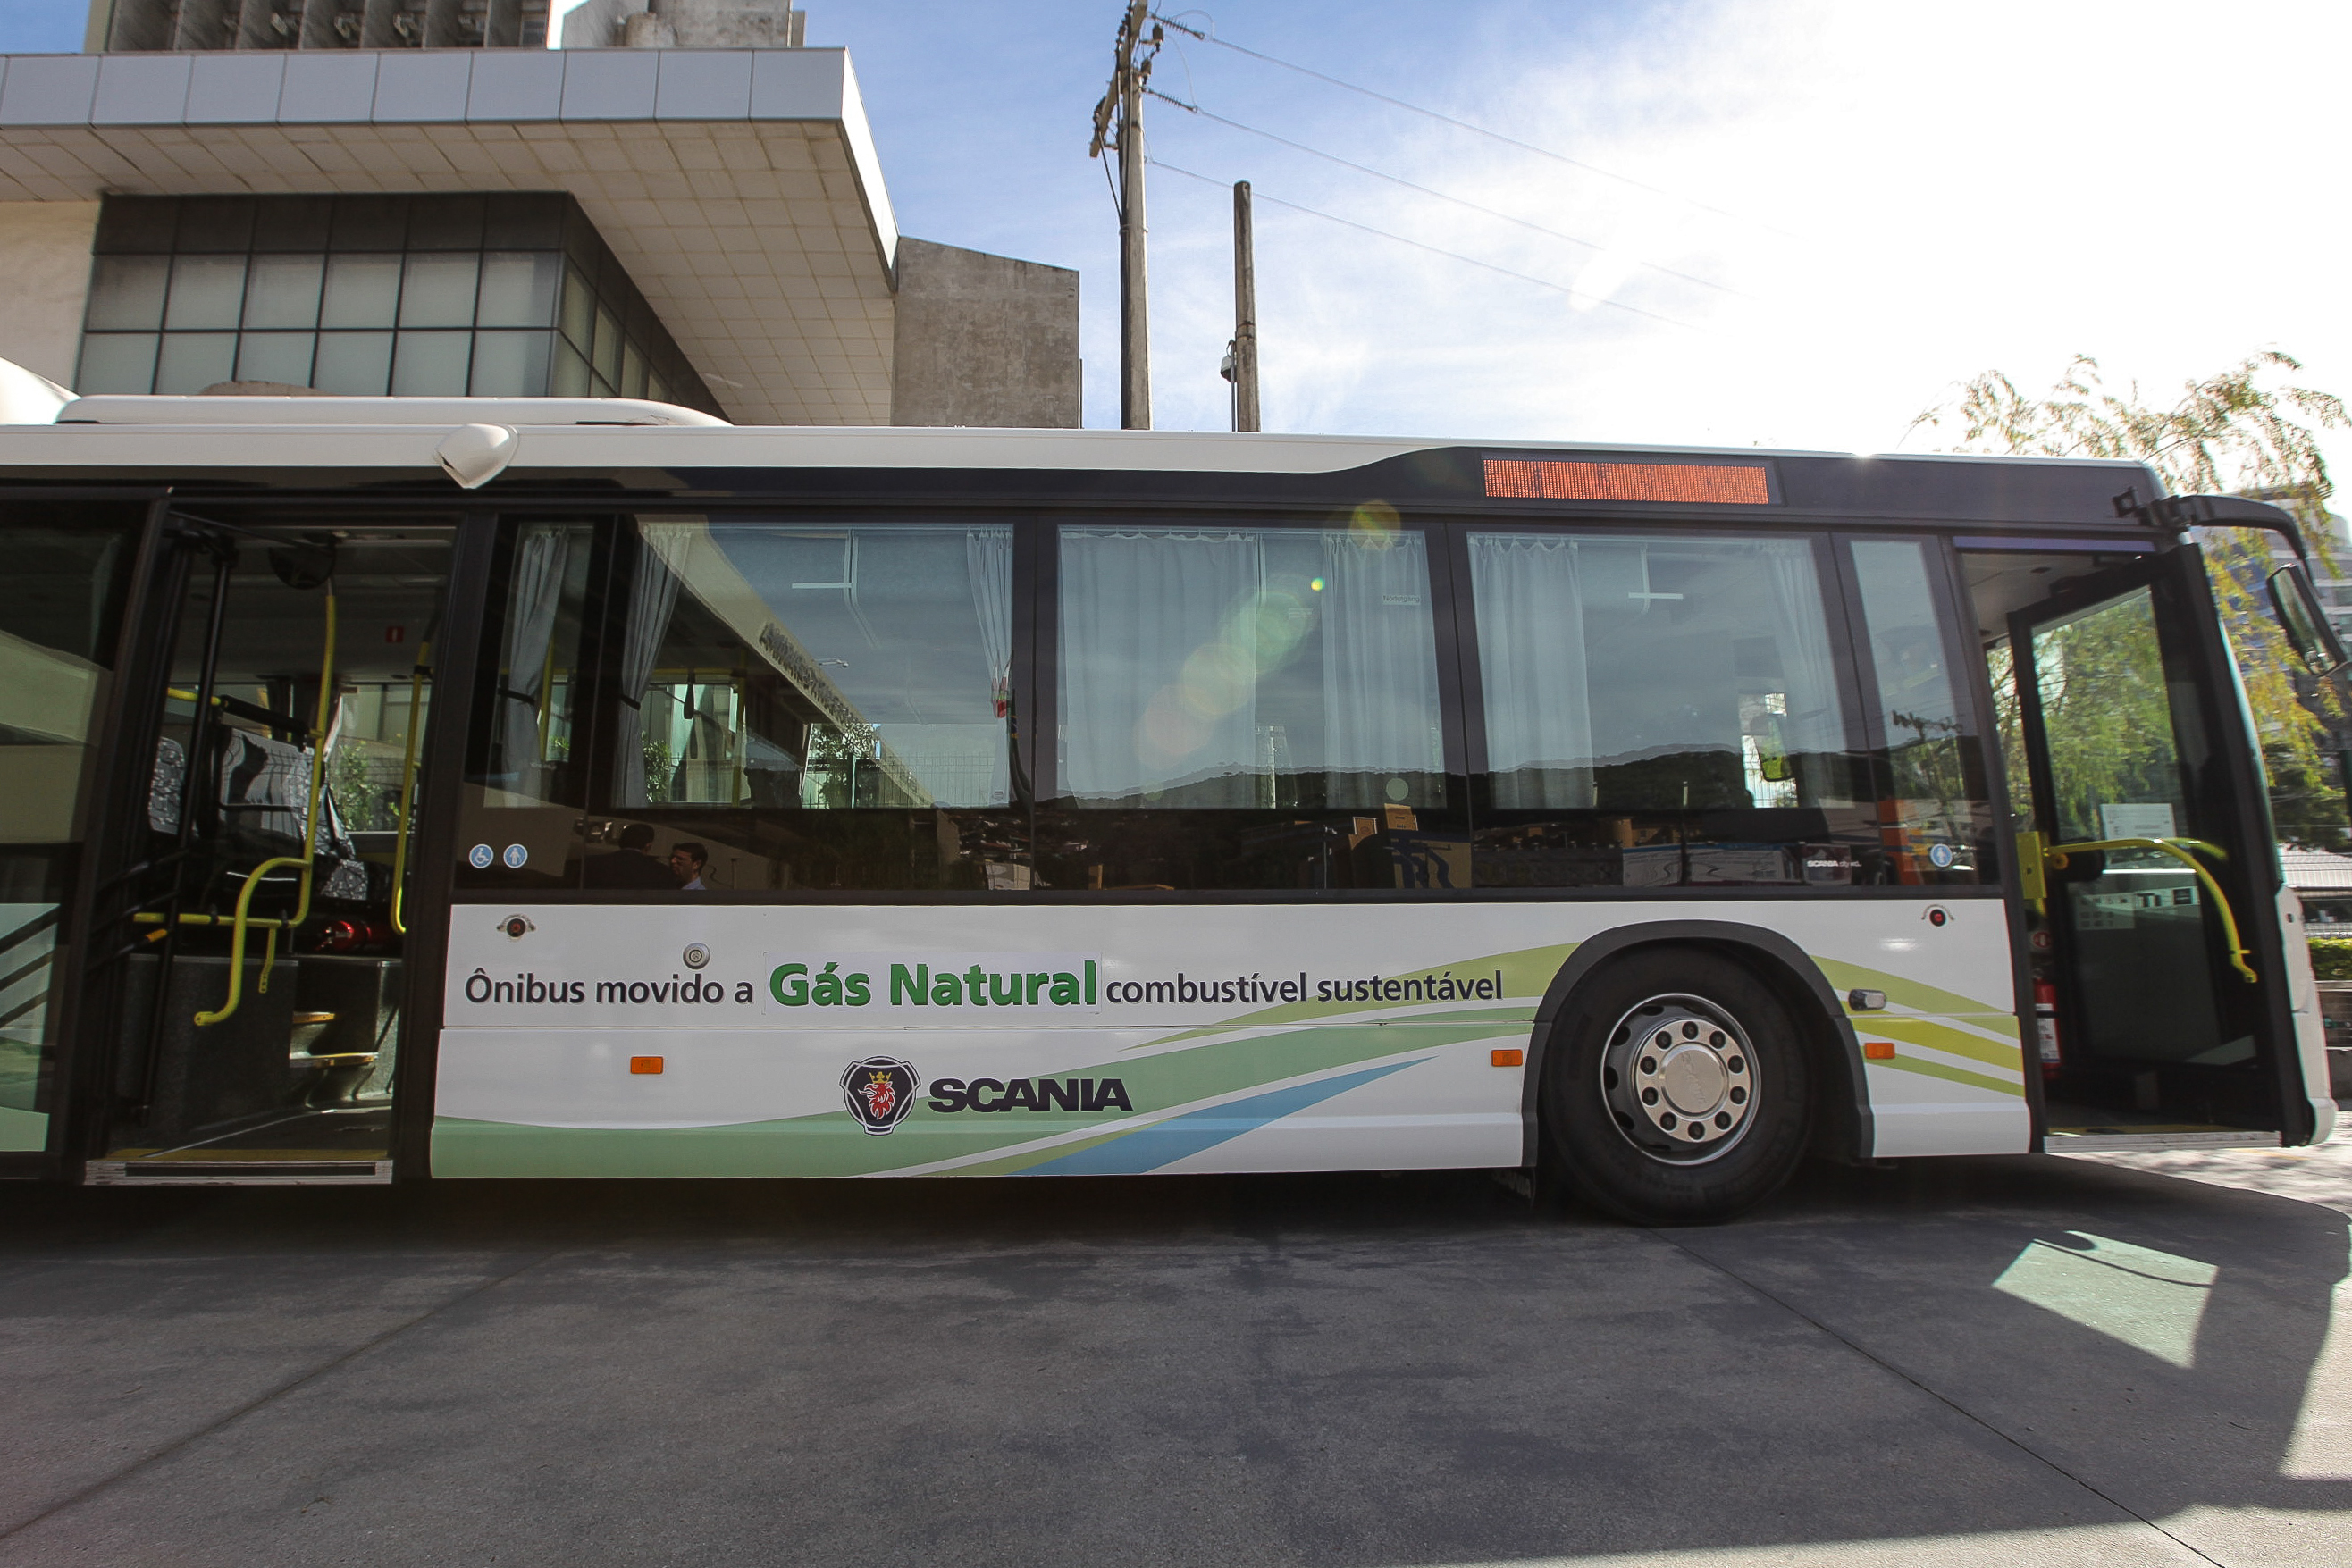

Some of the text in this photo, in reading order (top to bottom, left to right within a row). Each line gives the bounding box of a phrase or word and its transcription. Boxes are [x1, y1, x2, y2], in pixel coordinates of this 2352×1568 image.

[465, 960, 1503, 1007] Ônibus movido a Gás Natural combustível sustentável
[928, 1077, 1134, 1113] SCANIA
